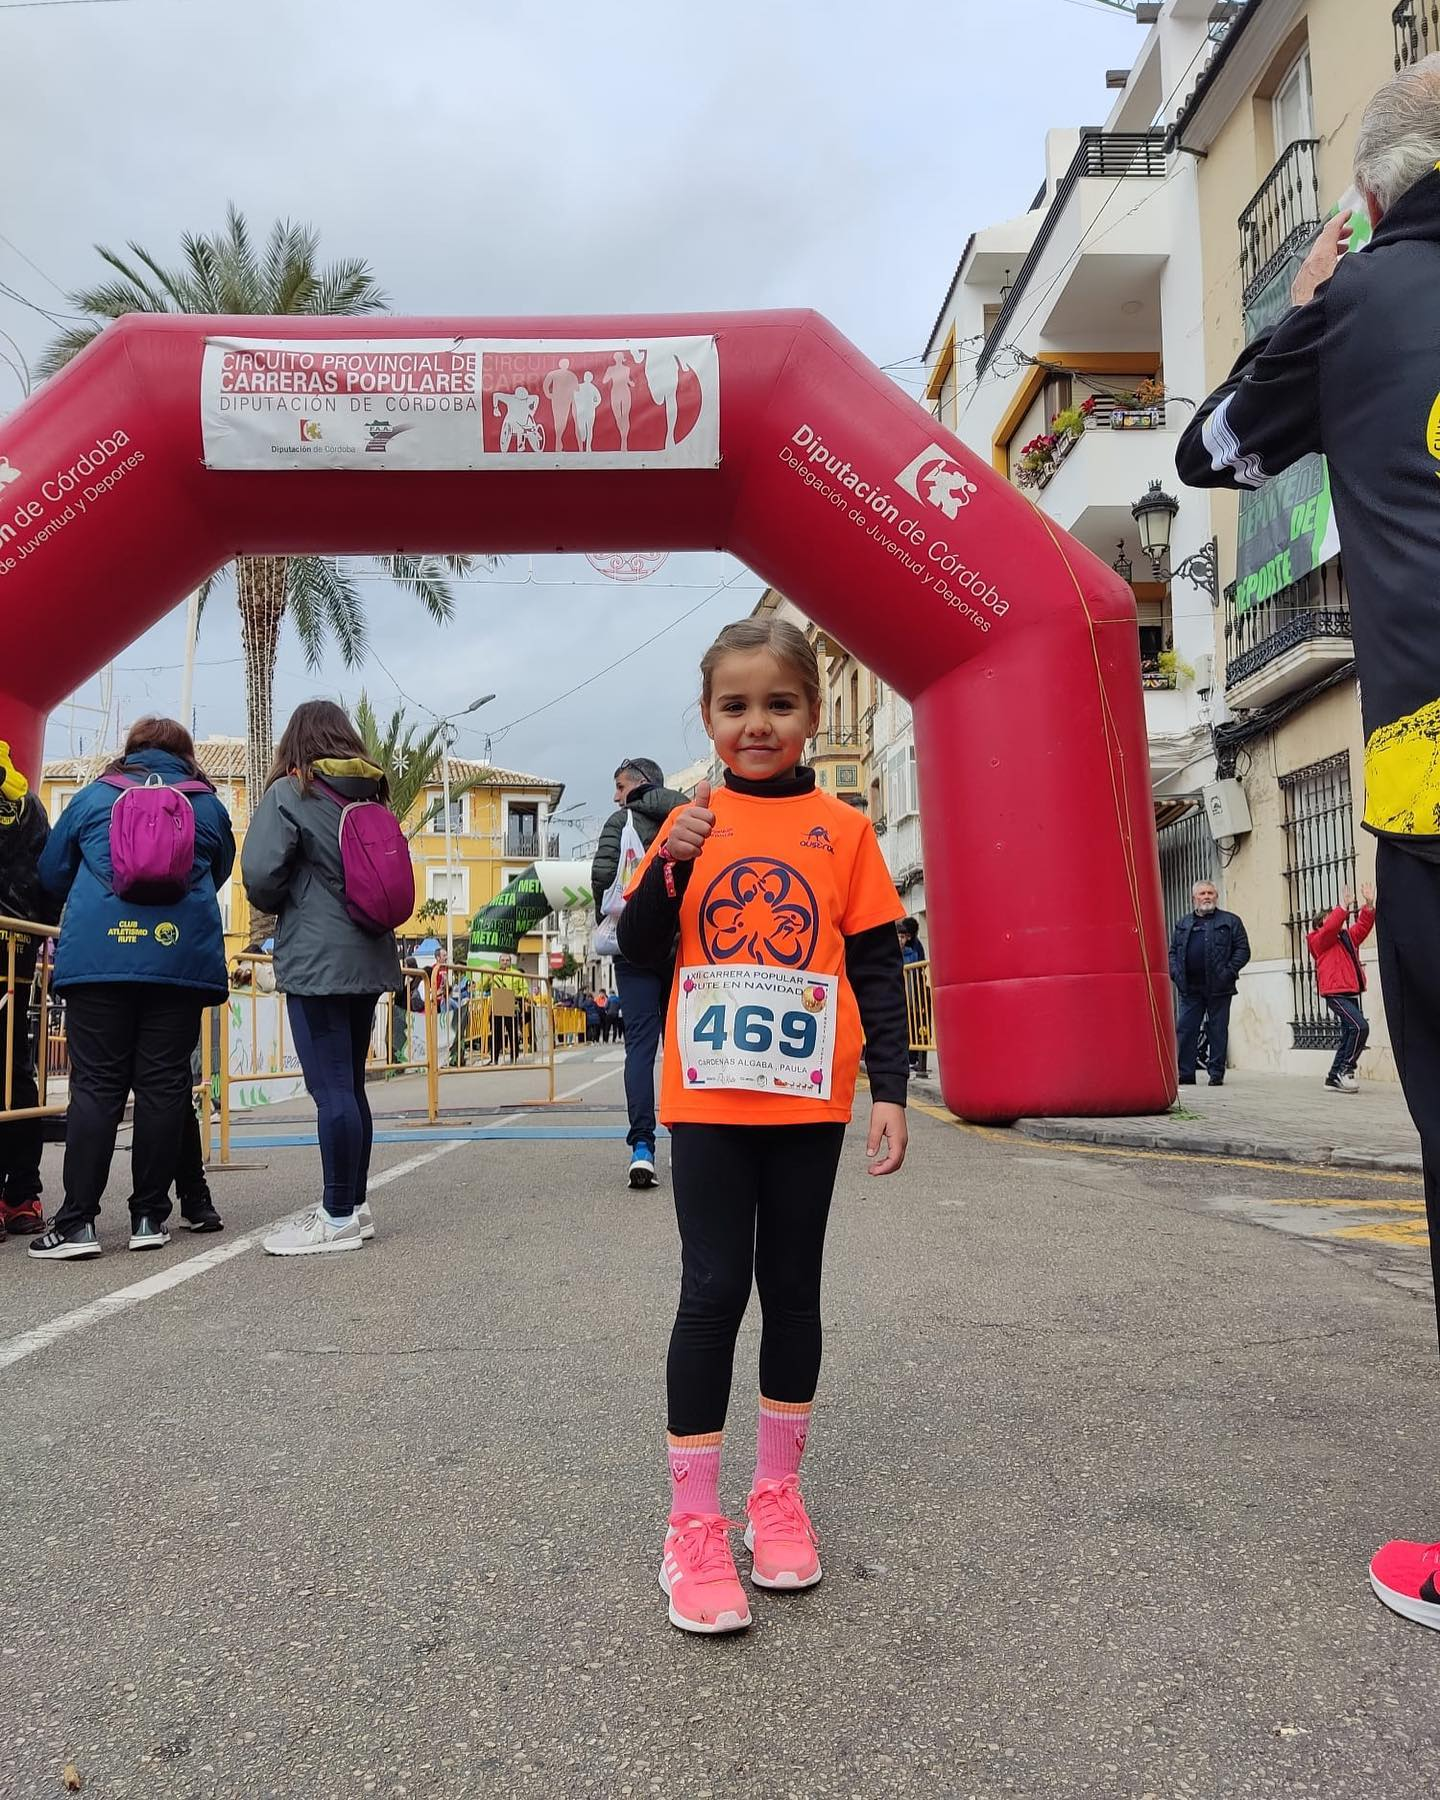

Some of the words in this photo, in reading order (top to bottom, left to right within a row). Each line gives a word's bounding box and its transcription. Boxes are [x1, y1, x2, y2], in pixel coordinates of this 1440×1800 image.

[222, 352, 314, 372] CIRCUITO
[321, 354, 444, 373] PROVINCIAL
[451, 355, 477, 372] DE
[221, 371, 339, 393] CARRERAS
[346, 372, 476, 393] POPULARES
[220, 393, 337, 412] DIPUTACIÓN
[350, 398, 373, 412] DE
[385, 393, 477, 412] CÓRDOBA
[14, 501, 44, 528] de
[41, 429, 130, 501] Córdoba
[17, 506, 76, 559] Juventud
[75, 499, 87, 513] y
[83, 450, 145, 502] Deportes
[792, 424, 899, 524] Diputación
[898, 518, 925, 546] de
[927, 541, 1010, 617] Córdoba
[1290, 503, 1317, 542] DE
[778, 446, 848, 512] Delegación
[848, 508, 867, 528] de
[866, 523, 925, 576] Juventud
[921, 571, 934, 584] y
[933, 579, 992, 633] Deportes
[107, 928, 148, 936] ATLETISMO
[119, 920, 138, 928] CLUB
[118, 935, 137, 943] RUTE
[471, 931, 499, 946] META
[702, 970, 751, 979] CARRERA
[753, 971, 804, 985] POPULAR
[724, 981, 741, 989] EN
[744, 981, 804, 995] NAVIDAD
[693, 1003, 818, 1059] 469
